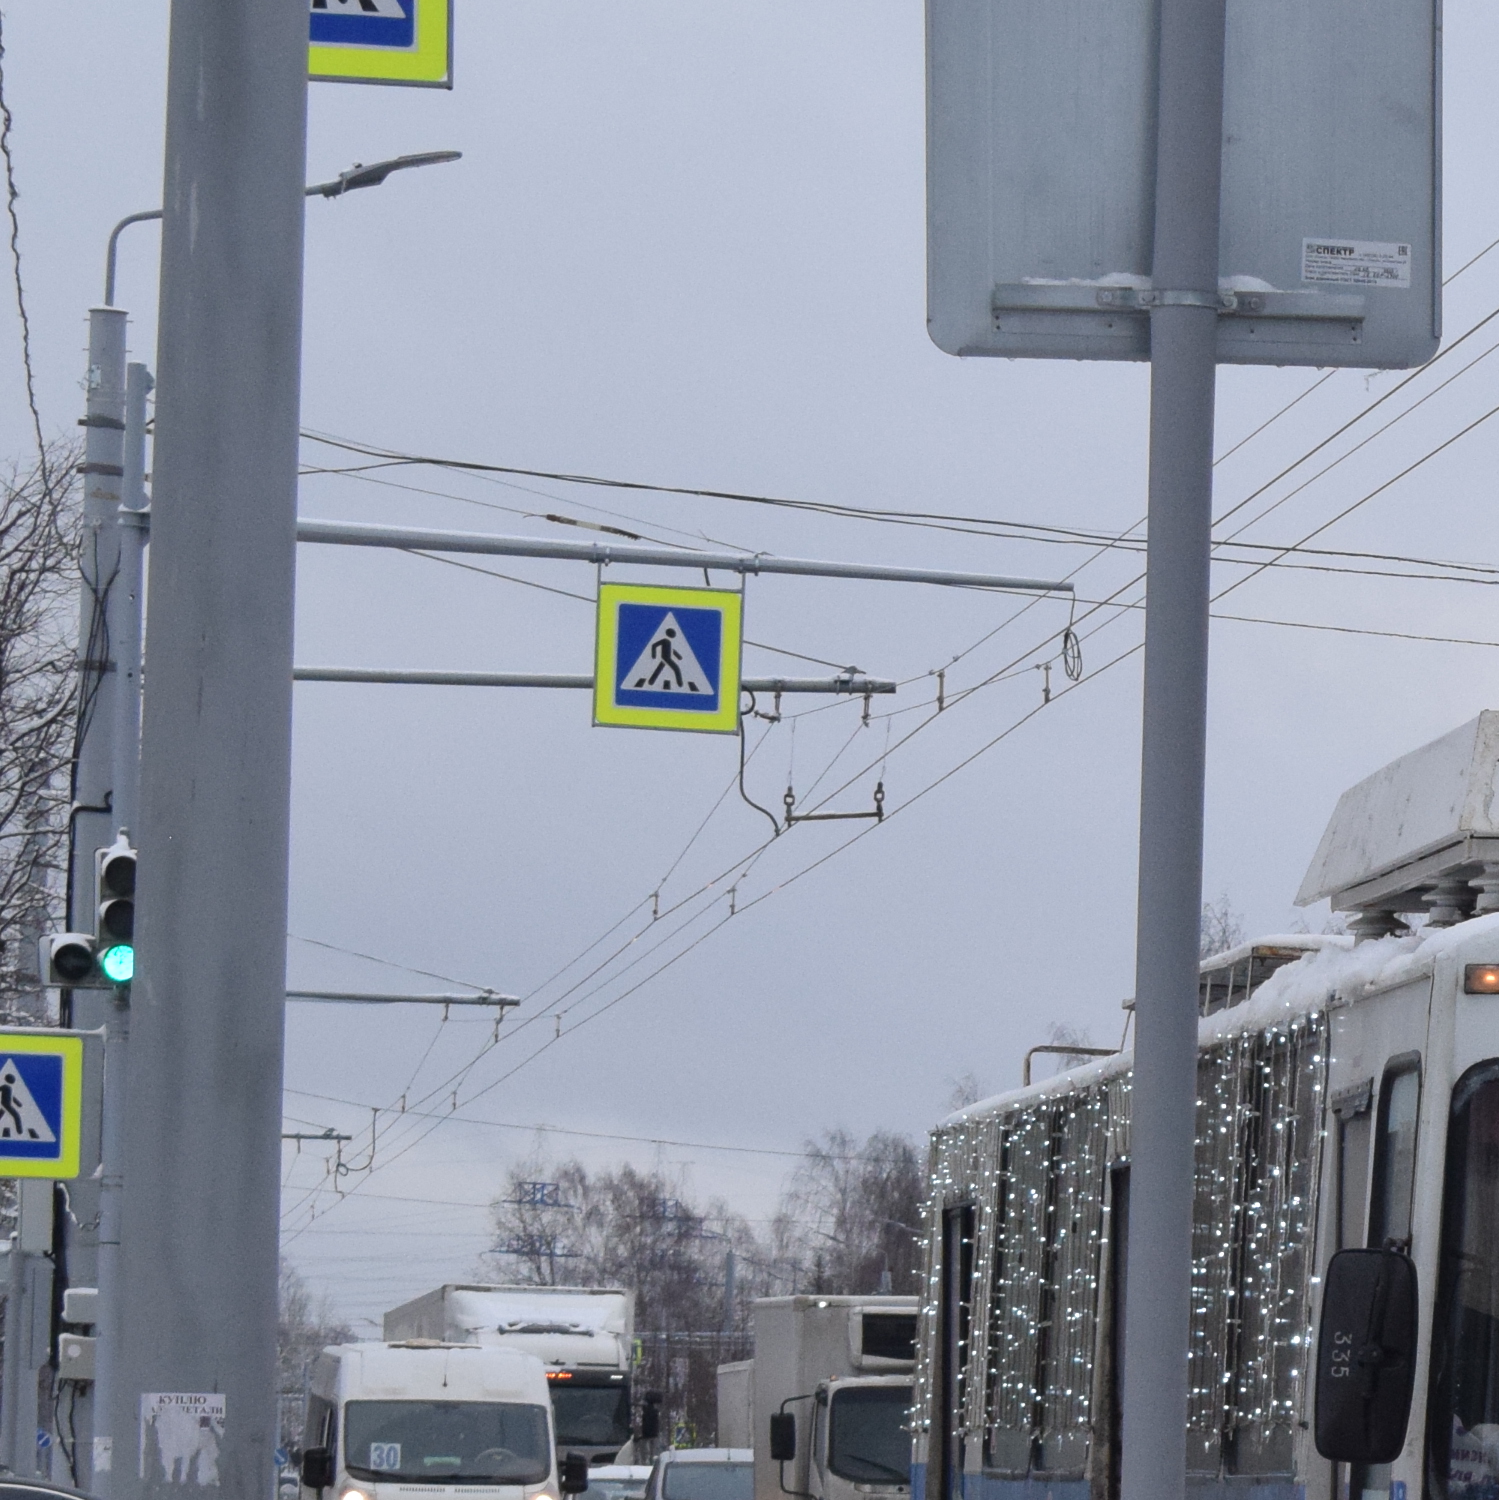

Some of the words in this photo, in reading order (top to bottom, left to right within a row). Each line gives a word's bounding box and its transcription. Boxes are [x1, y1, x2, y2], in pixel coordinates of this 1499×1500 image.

[1316, 246, 1355, 256] СПЕКТР
[1331, 1331, 1353, 1378] 335
[159, 1395, 207, 1405] КУПЛЮ
[373, 1444, 399, 1469] 30
